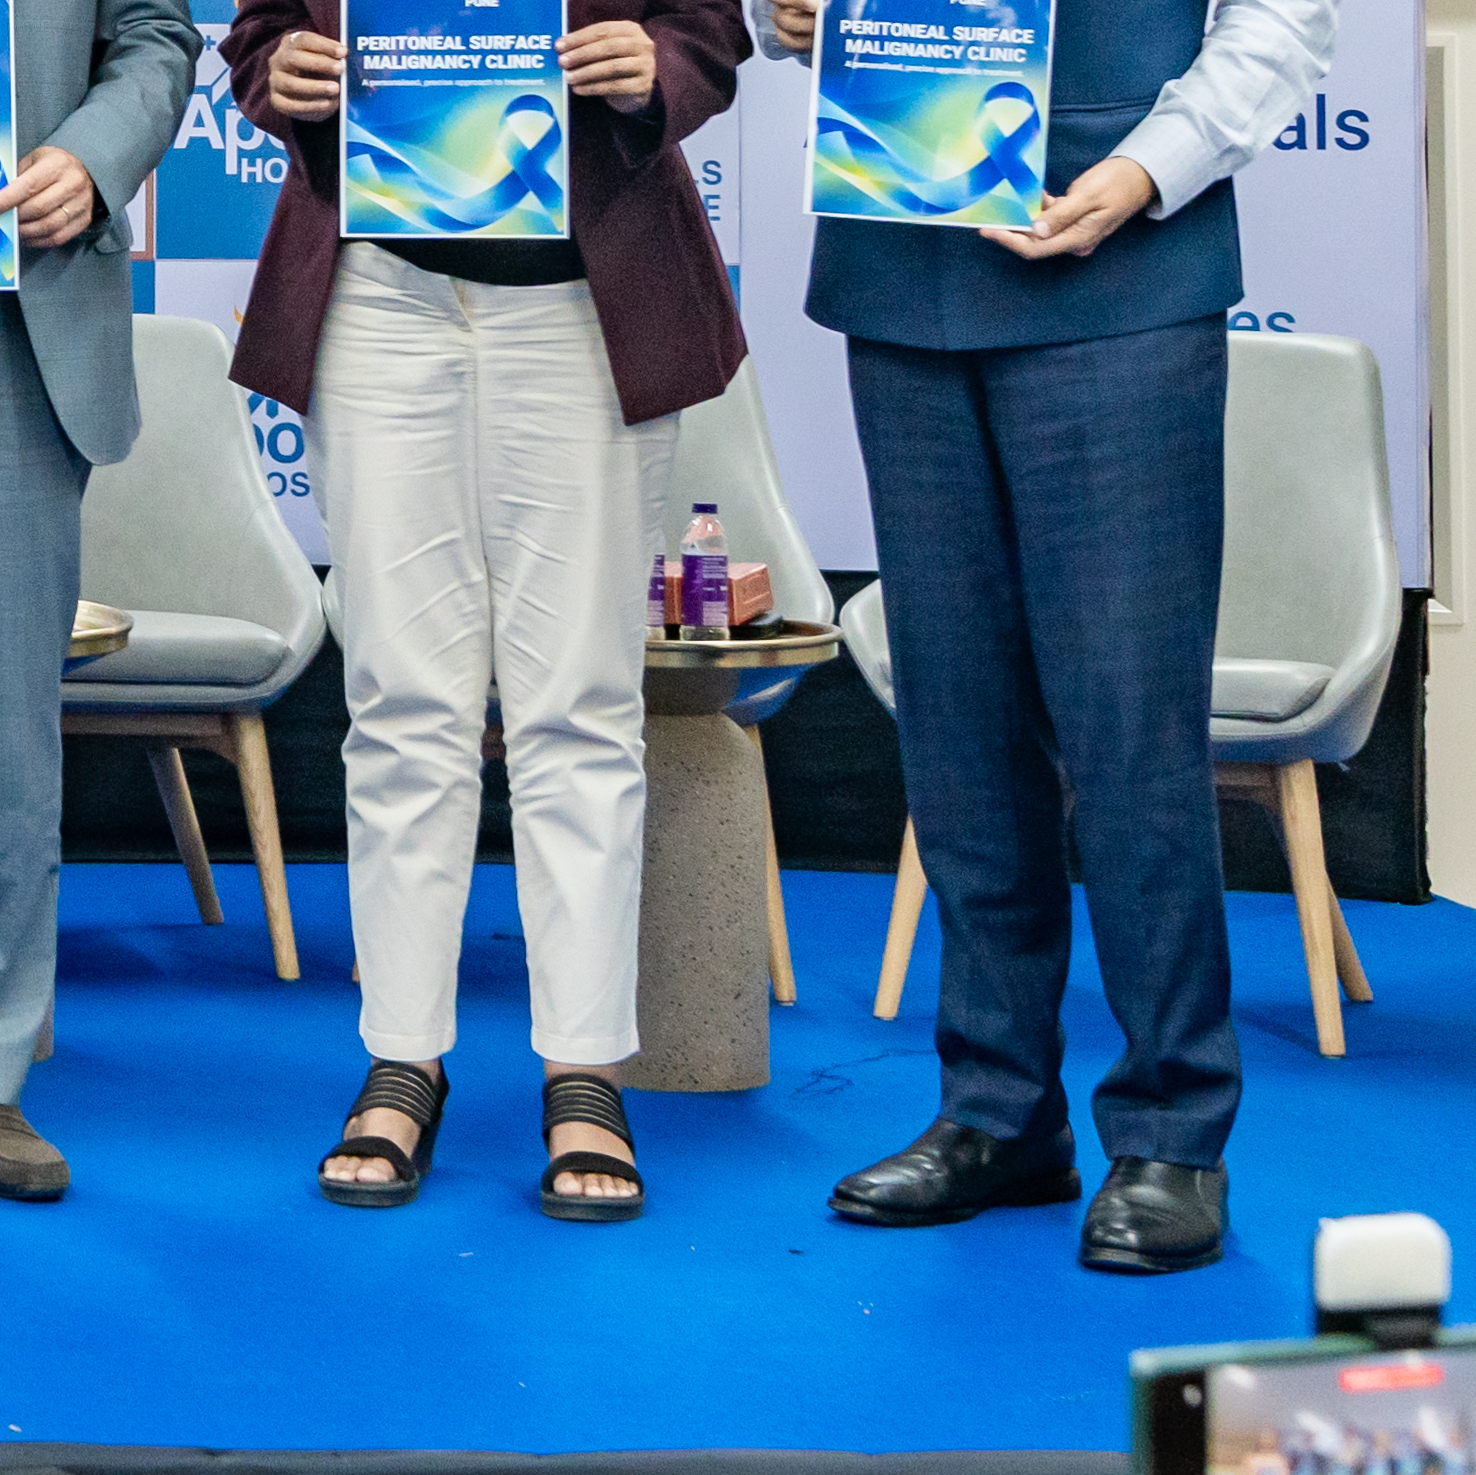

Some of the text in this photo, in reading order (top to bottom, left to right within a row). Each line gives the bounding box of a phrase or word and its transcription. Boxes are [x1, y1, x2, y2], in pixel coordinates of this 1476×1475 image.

[839, 19, 1035, 44] PERITONEAL SURFACE
[356, 34, 552, 51] PERITONEAL SURFACE
[844, 38, 1027, 63] MALIGNANCY CLINIC
[363, 54, 545, 70] MALIGNANCY CLINIC
